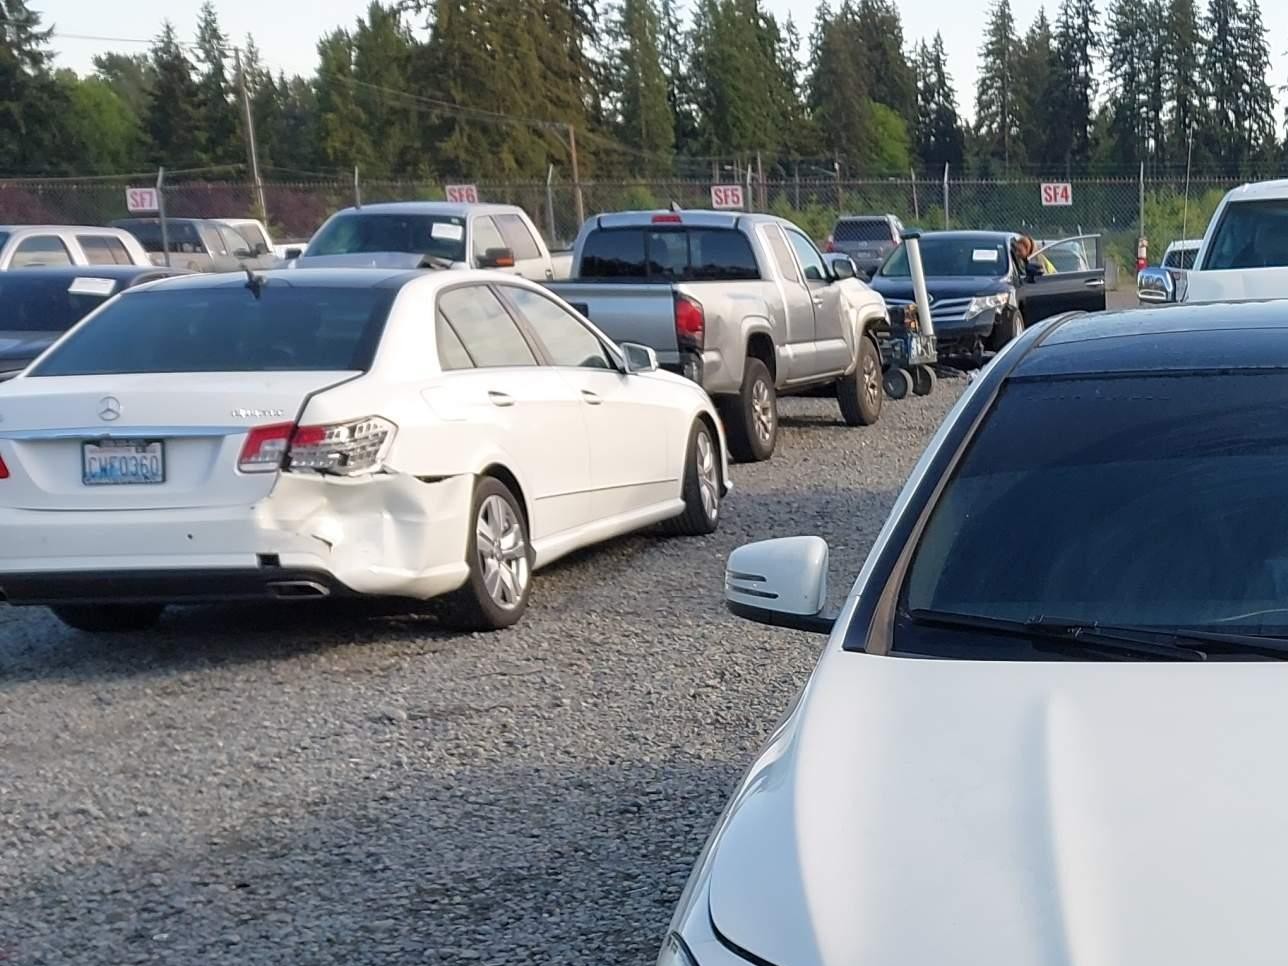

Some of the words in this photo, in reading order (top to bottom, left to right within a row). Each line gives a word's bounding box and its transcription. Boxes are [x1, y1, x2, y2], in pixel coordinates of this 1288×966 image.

[130, 190, 153, 209] SF7
[447, 186, 476, 203] SF6
[713, 187, 740, 205] SF5
[1043, 186, 1069, 203] SF4
